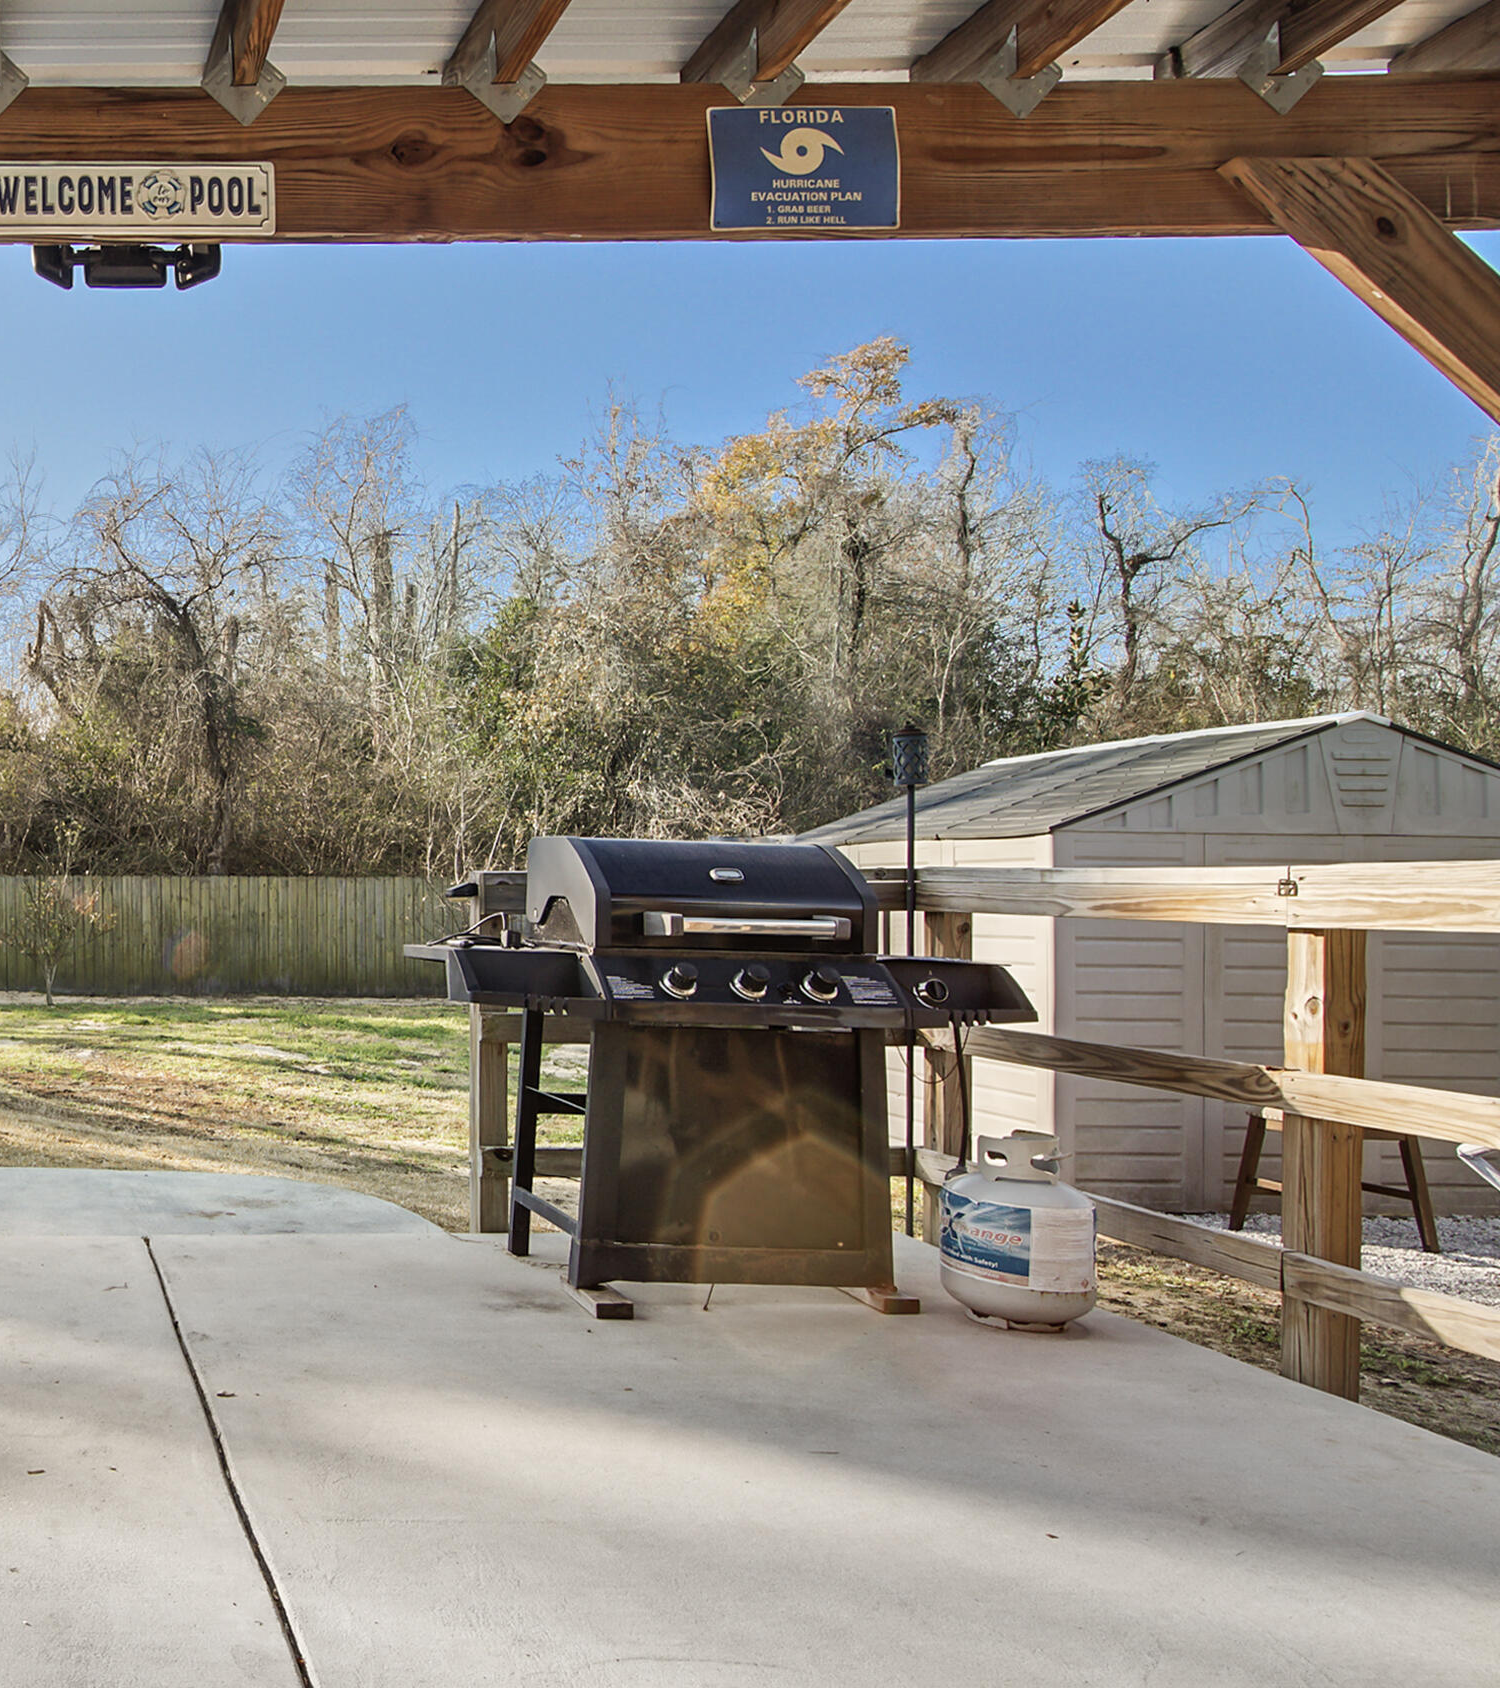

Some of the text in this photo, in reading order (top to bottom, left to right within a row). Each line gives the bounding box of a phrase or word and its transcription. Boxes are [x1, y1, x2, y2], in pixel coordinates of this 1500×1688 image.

[759, 110, 844, 124] FLORIDA
[772, 179, 840, 189] HURRICANE
[157, 184, 171, 195] to
[153, 195, 170, 204] our
[189, 175, 263, 216] POOL
[751, 191, 862, 202] EVACUATION PLAN
[766, 205, 831, 214] 1. GRAB BEER
[766, 216, 846, 225] 2. RUN LIKE HELL
